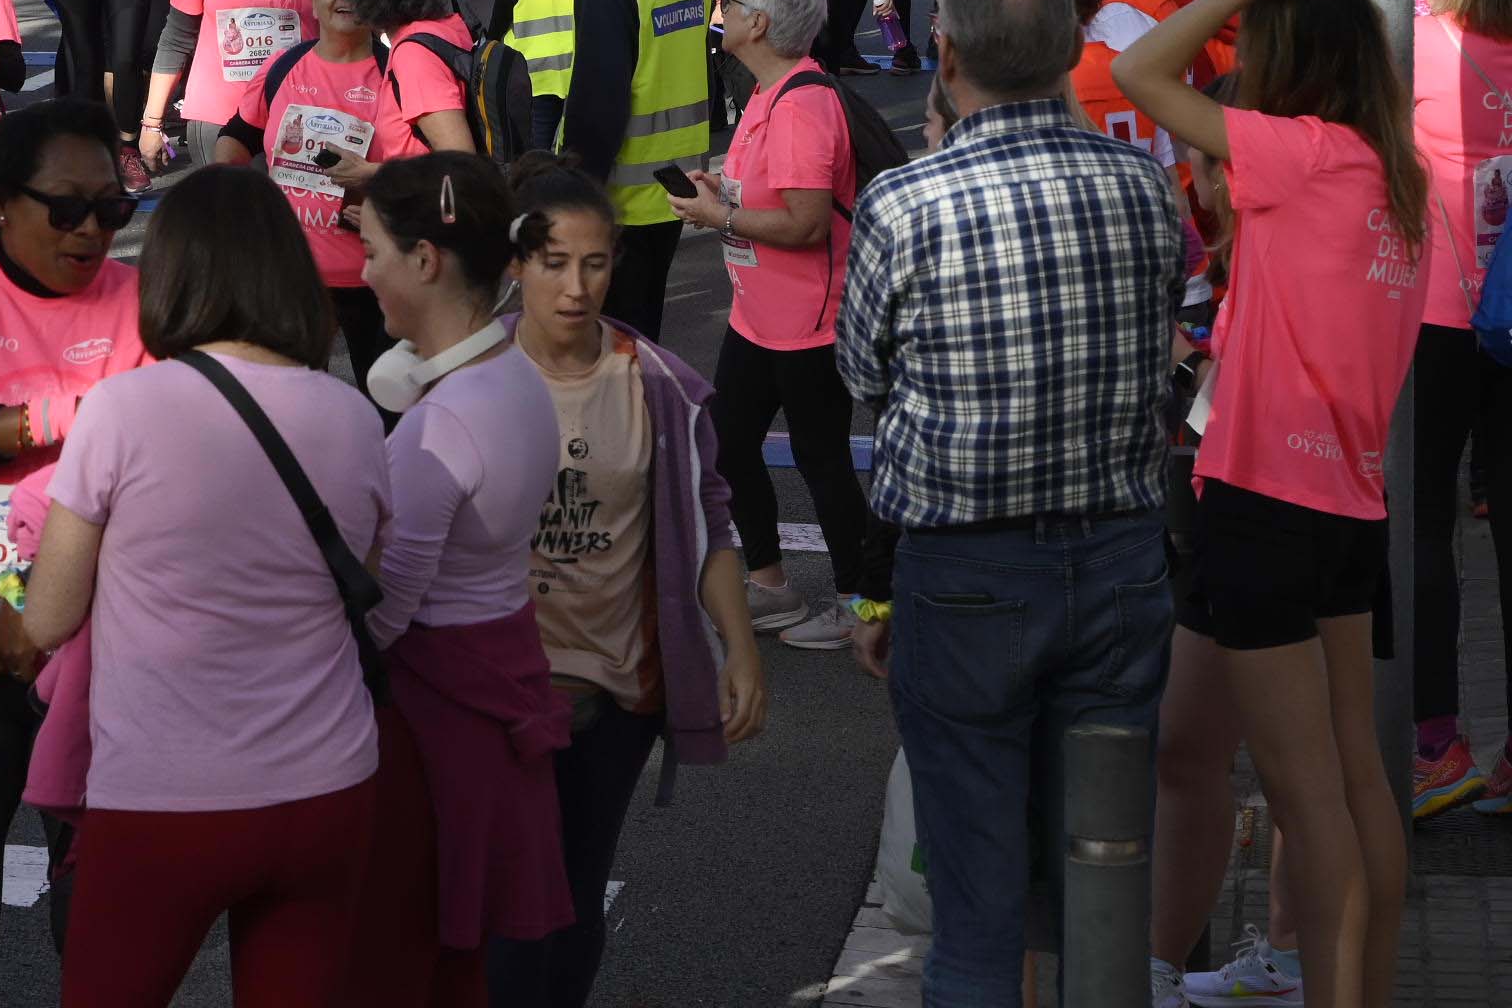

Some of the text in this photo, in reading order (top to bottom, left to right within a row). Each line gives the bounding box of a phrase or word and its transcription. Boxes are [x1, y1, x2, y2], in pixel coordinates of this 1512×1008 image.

[243, 18, 274, 27] ASTURIANA
[245, 35, 274, 48] 016
[249, 49, 271, 57] 26826
[309, 119, 342, 131] ASTURIANA
[277, 171, 305, 183] OYSHO
